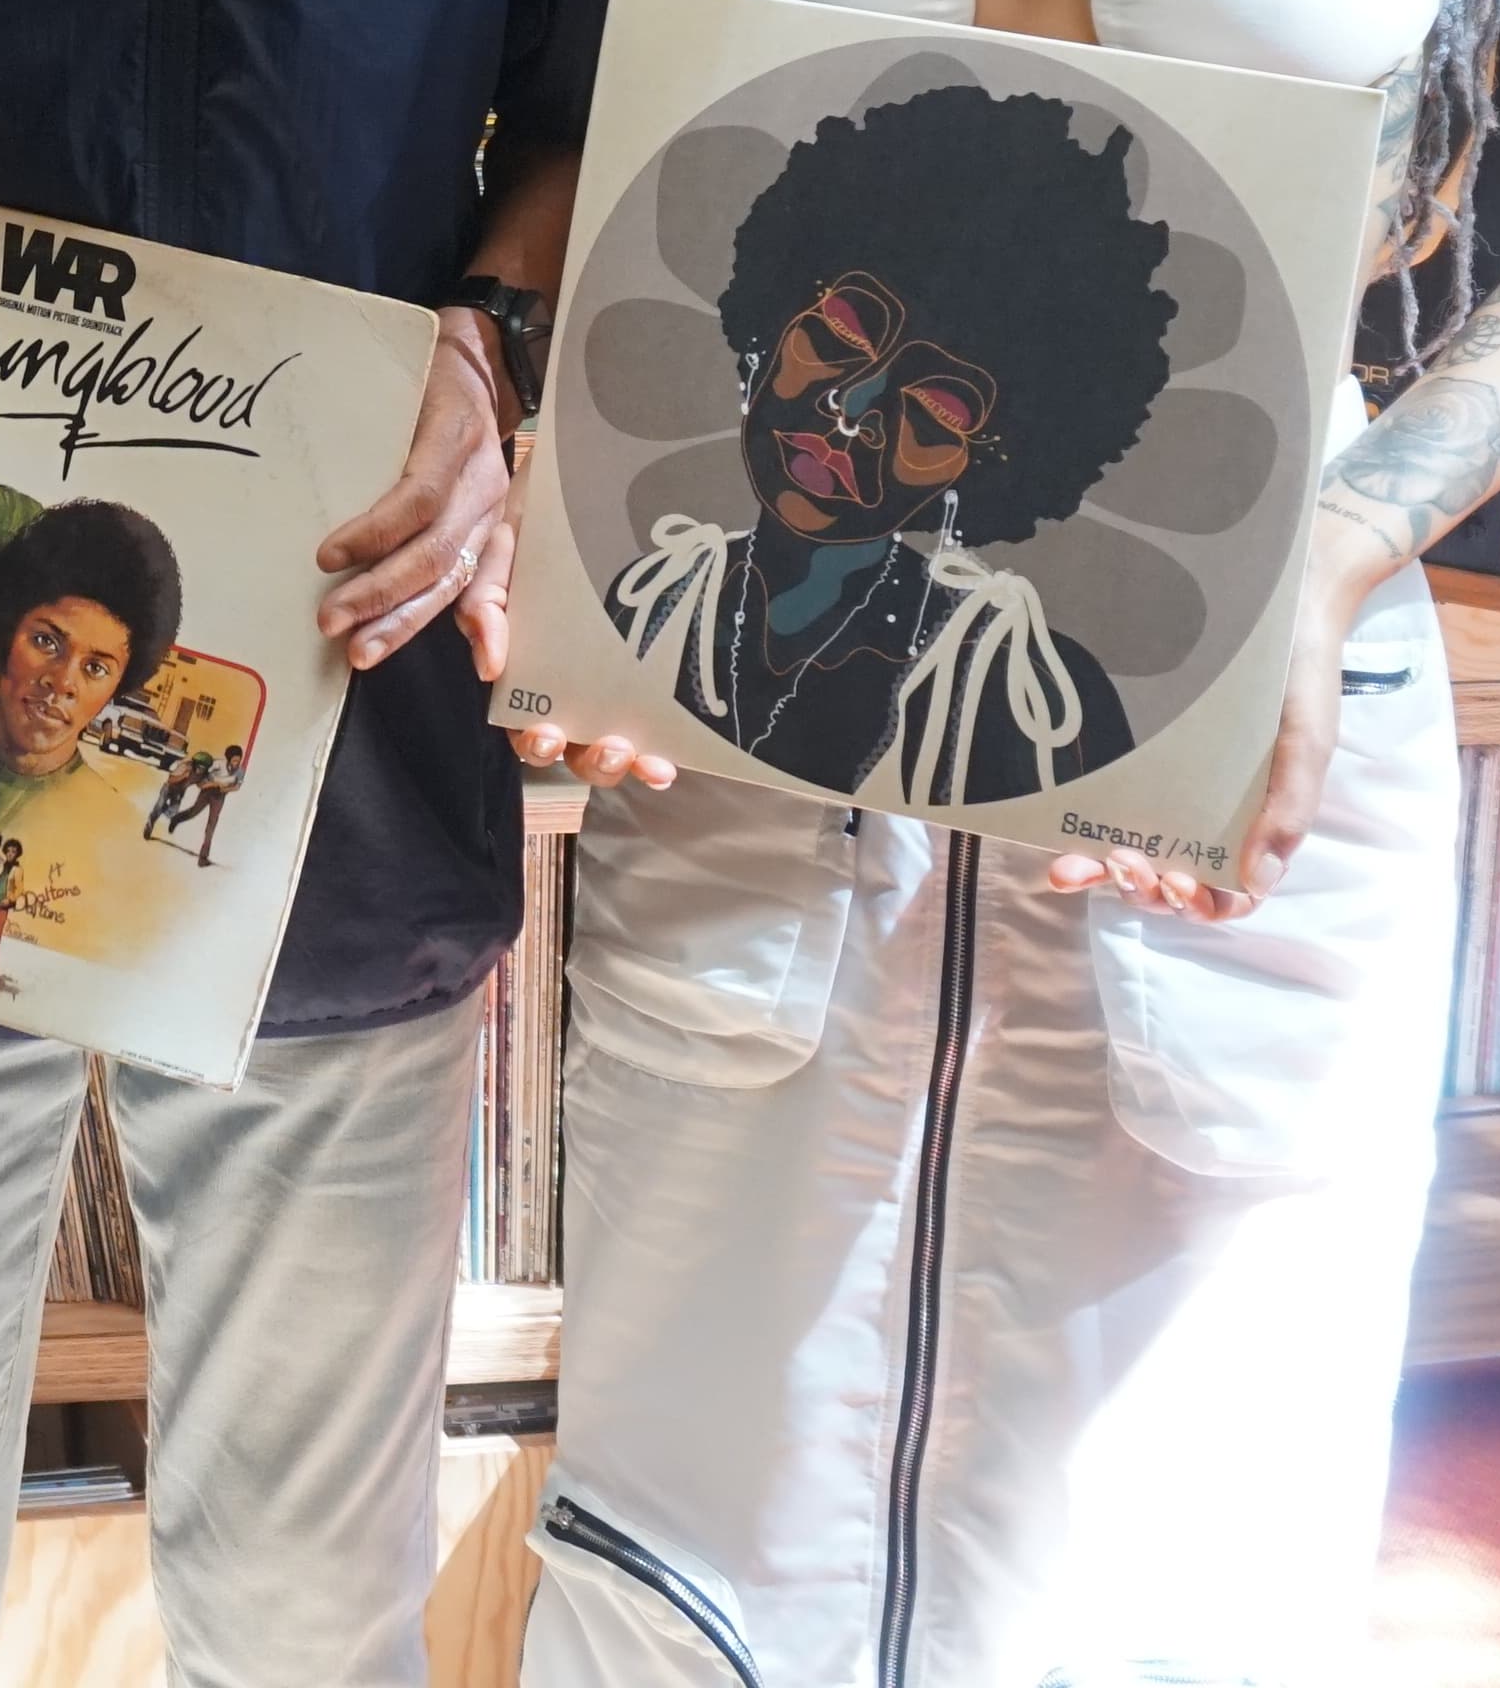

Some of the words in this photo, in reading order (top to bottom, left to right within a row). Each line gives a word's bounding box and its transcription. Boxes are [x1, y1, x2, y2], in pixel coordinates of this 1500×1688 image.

[1, 222, 136, 322] WAR
[26, 303, 52, 319] MOTION
[52, 308, 81, 326] PICTURE
[81, 314, 124, 337] SOUNDTRACK
[508, 687, 552, 717] SIO
[1061, 812, 1163, 859] Sarang
